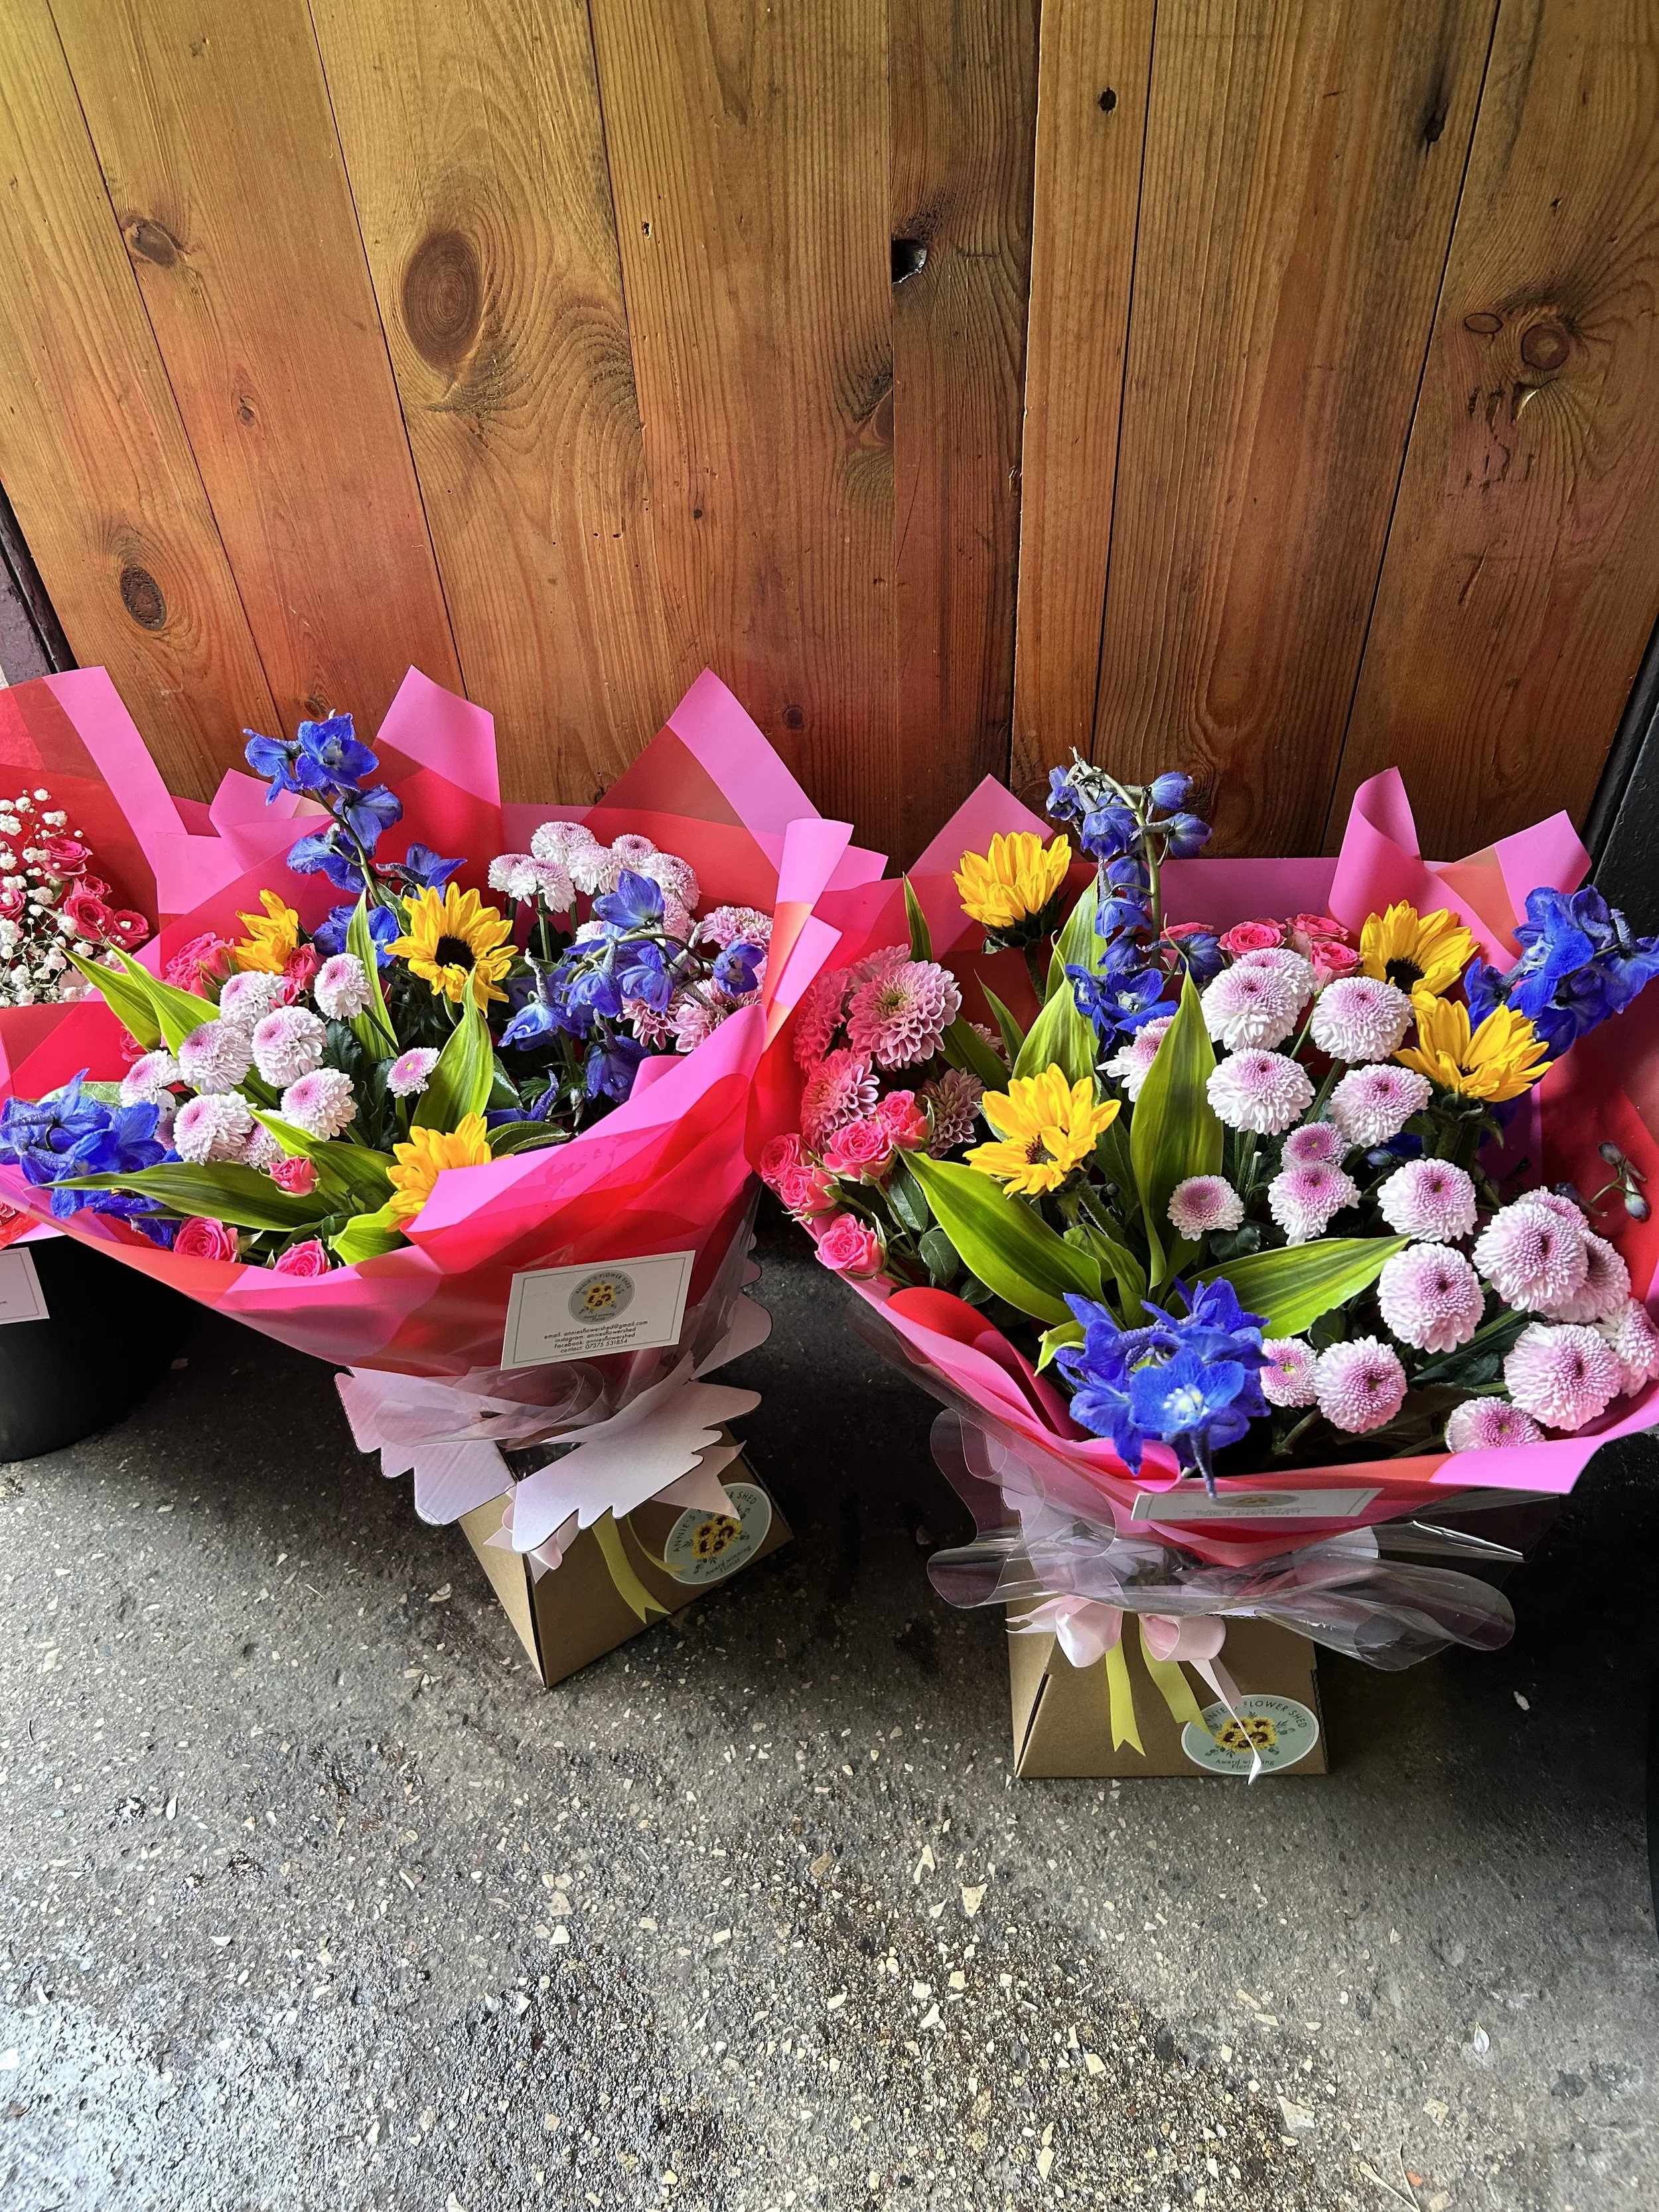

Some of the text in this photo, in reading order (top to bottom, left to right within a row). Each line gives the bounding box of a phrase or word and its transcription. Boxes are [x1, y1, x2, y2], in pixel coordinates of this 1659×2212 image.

[622, 1278, 632, 1289] SHED
[563, 1320, 648, 1337] anniesflowershed@gmail.com
[587, 1327, 636, 1338] anniesflowershed
[586, 1332, 636, 1344] anniesflowershed
[674, 1491, 757, 1552] ANNIE'S SHED
[705, 1545, 753, 1577] Award winning
[1243, 1700, 1288, 1712] FLOWER
[1288, 1710, 1307, 1728] SHED
